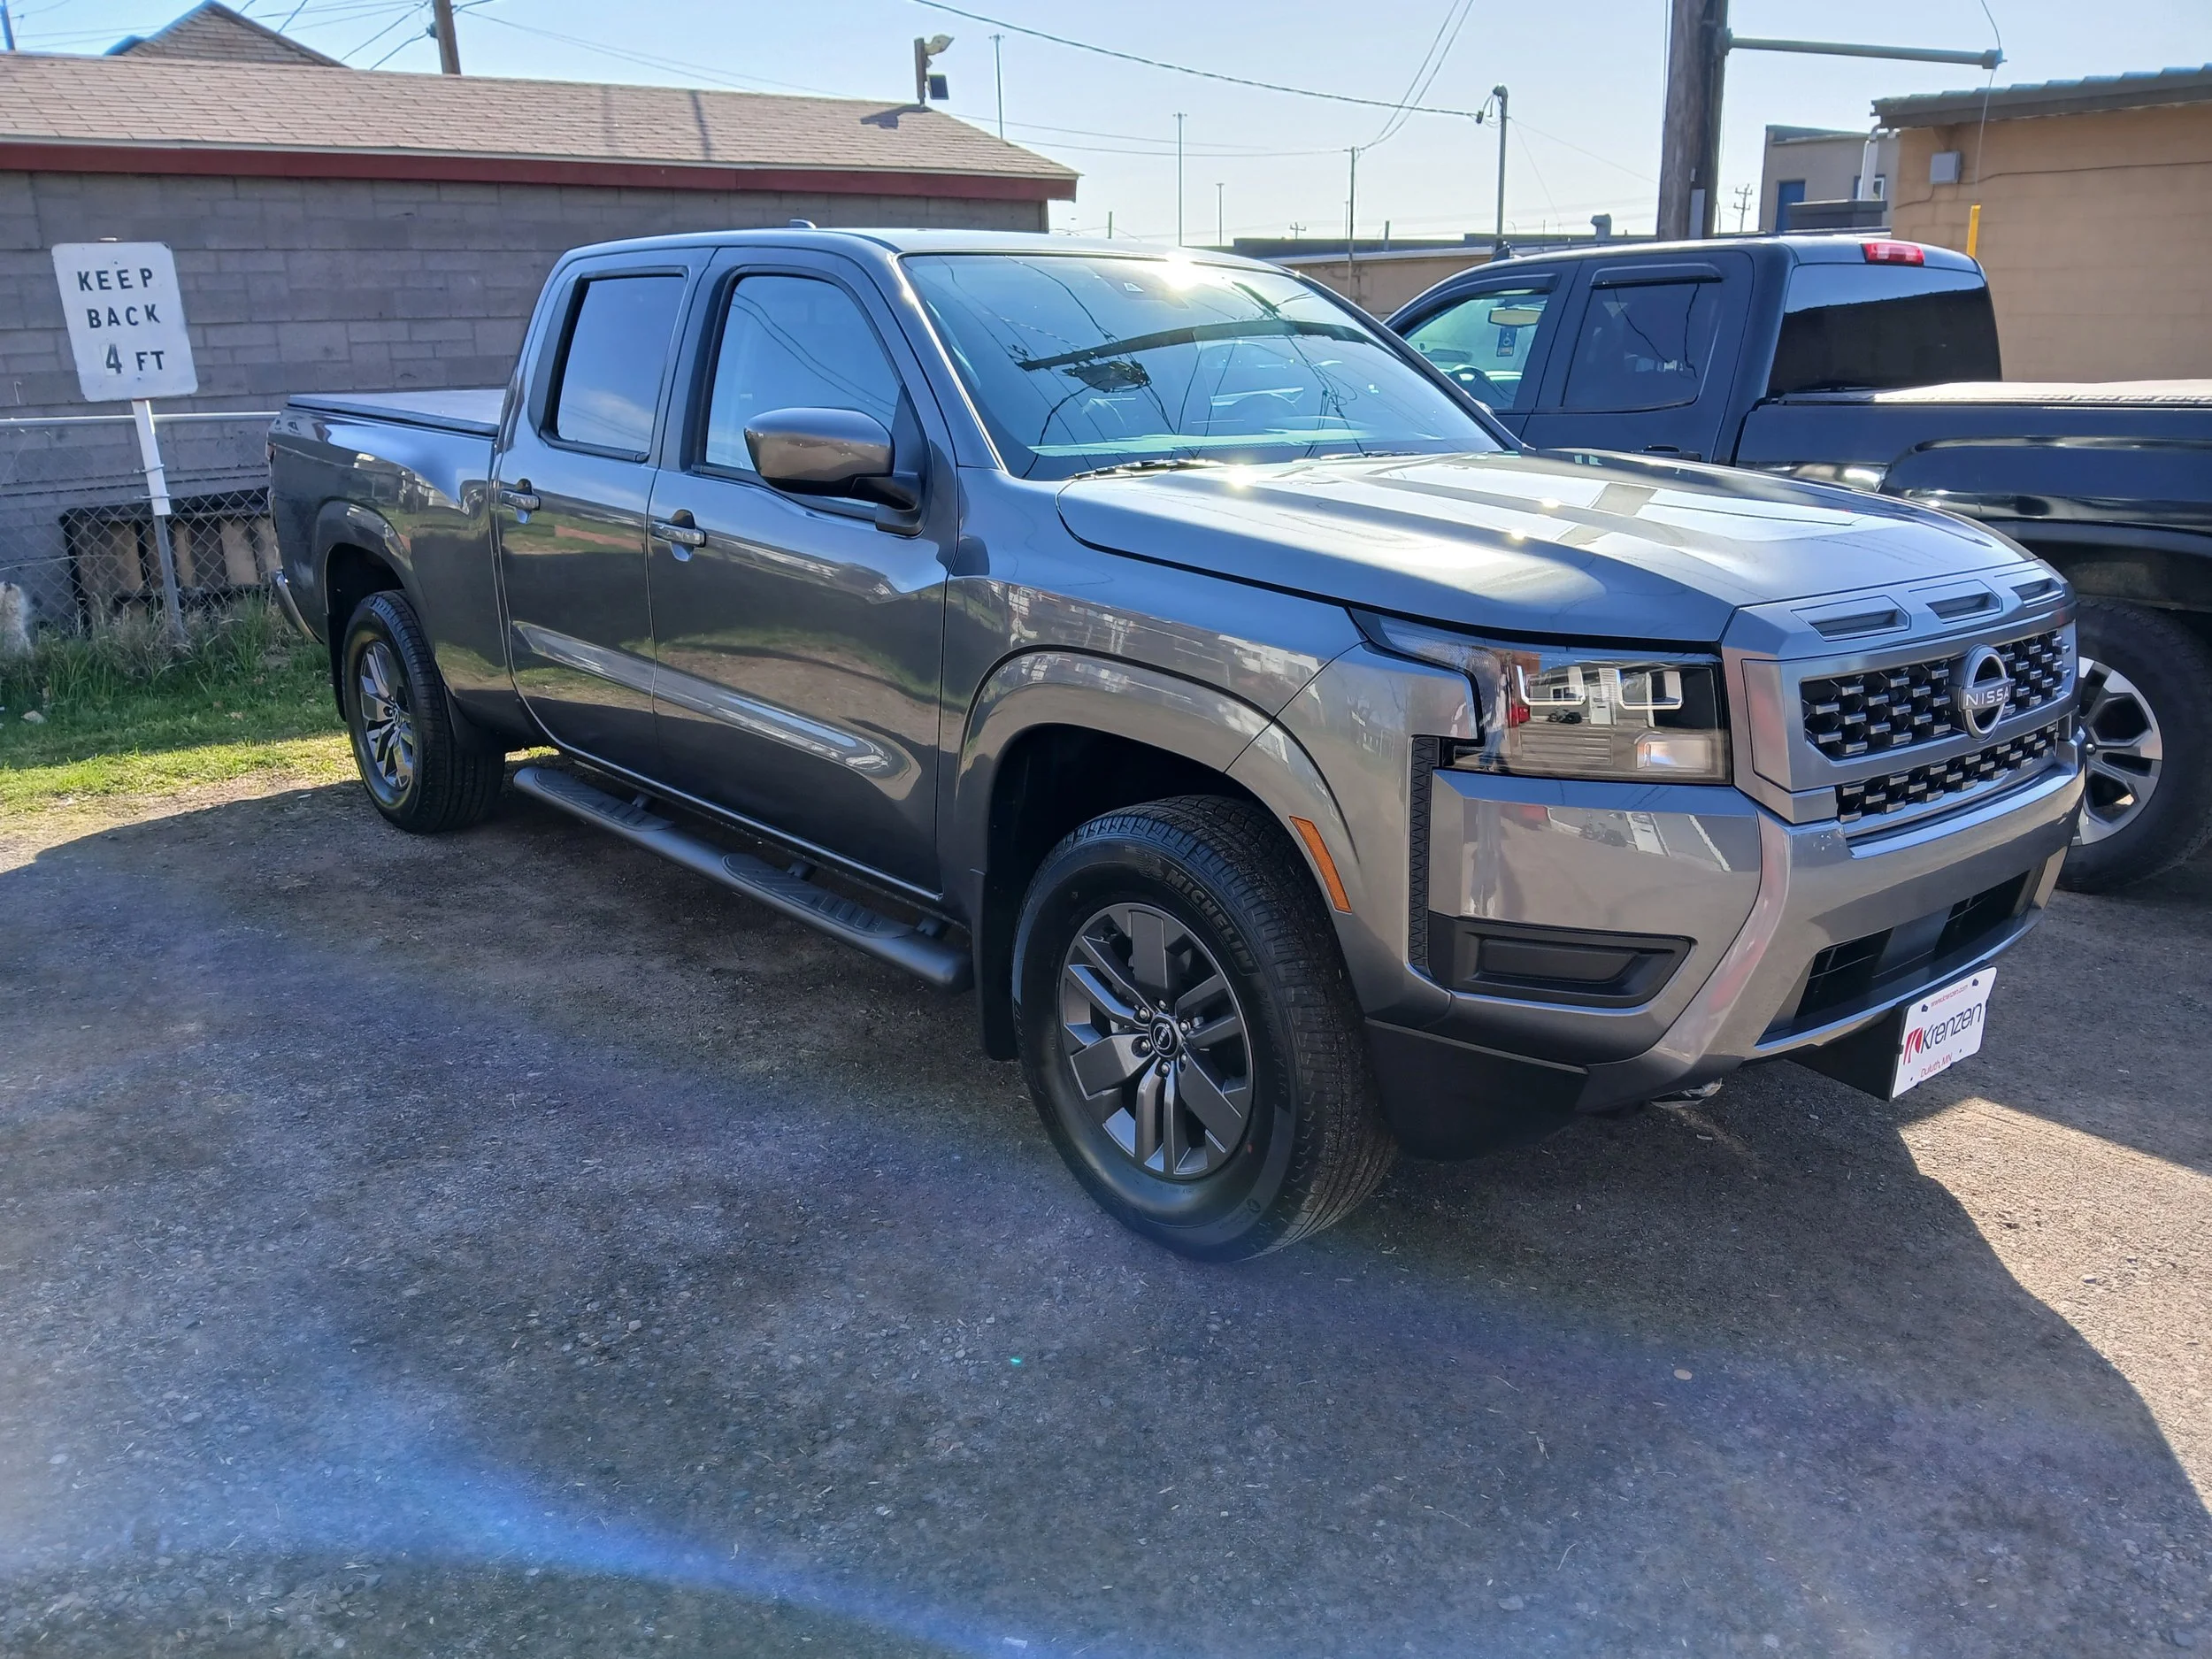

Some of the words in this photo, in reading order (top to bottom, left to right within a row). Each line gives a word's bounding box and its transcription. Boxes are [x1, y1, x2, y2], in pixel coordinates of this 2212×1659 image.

[77, 268, 153, 291] KEEP
[87, 304, 160, 328] BACK
[105, 343, 122, 374] 4
[135, 350, 165, 371] FT
[1965, 686, 2009, 706] NISSA
[1165, 869, 1255, 967] MICHELIN
[1920, 1002, 1983, 1054] Krenzen
